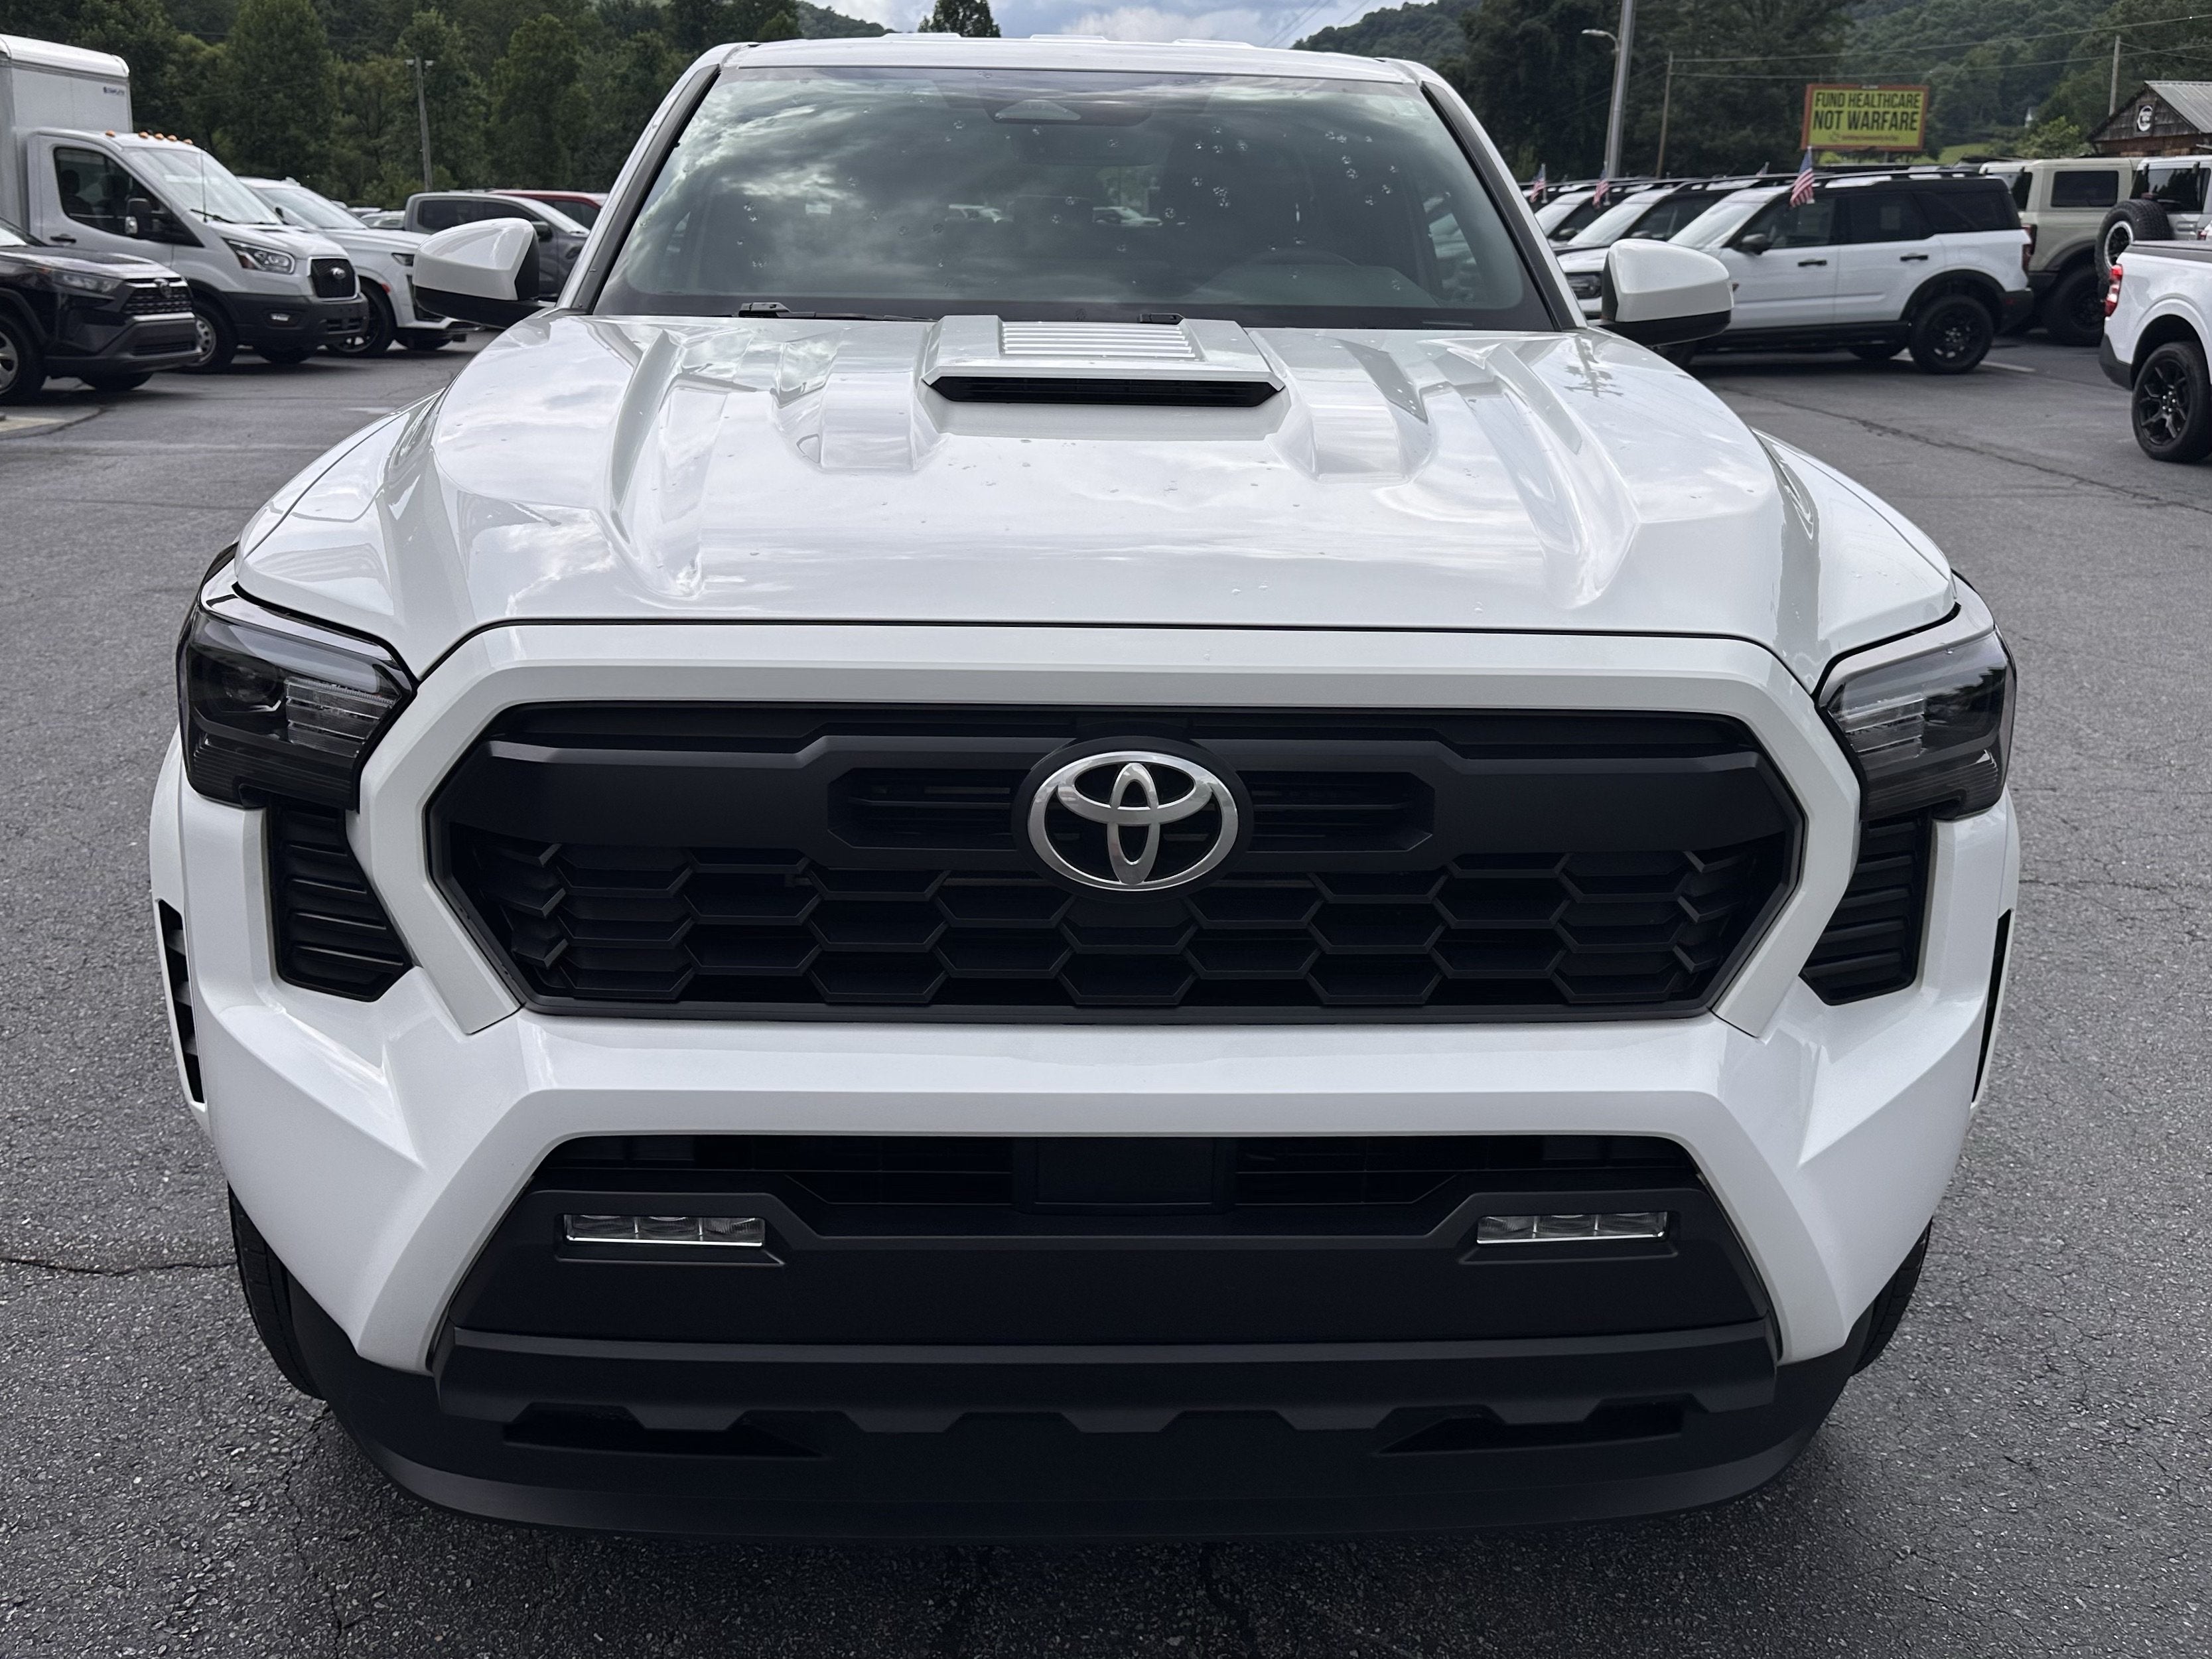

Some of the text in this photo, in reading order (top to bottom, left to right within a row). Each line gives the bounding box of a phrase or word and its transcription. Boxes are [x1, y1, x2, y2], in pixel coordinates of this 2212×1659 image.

[1815, 92, 1921, 109] FUND HEALTHCARE
[1813, 110, 1919, 131] NOT WARFARE
